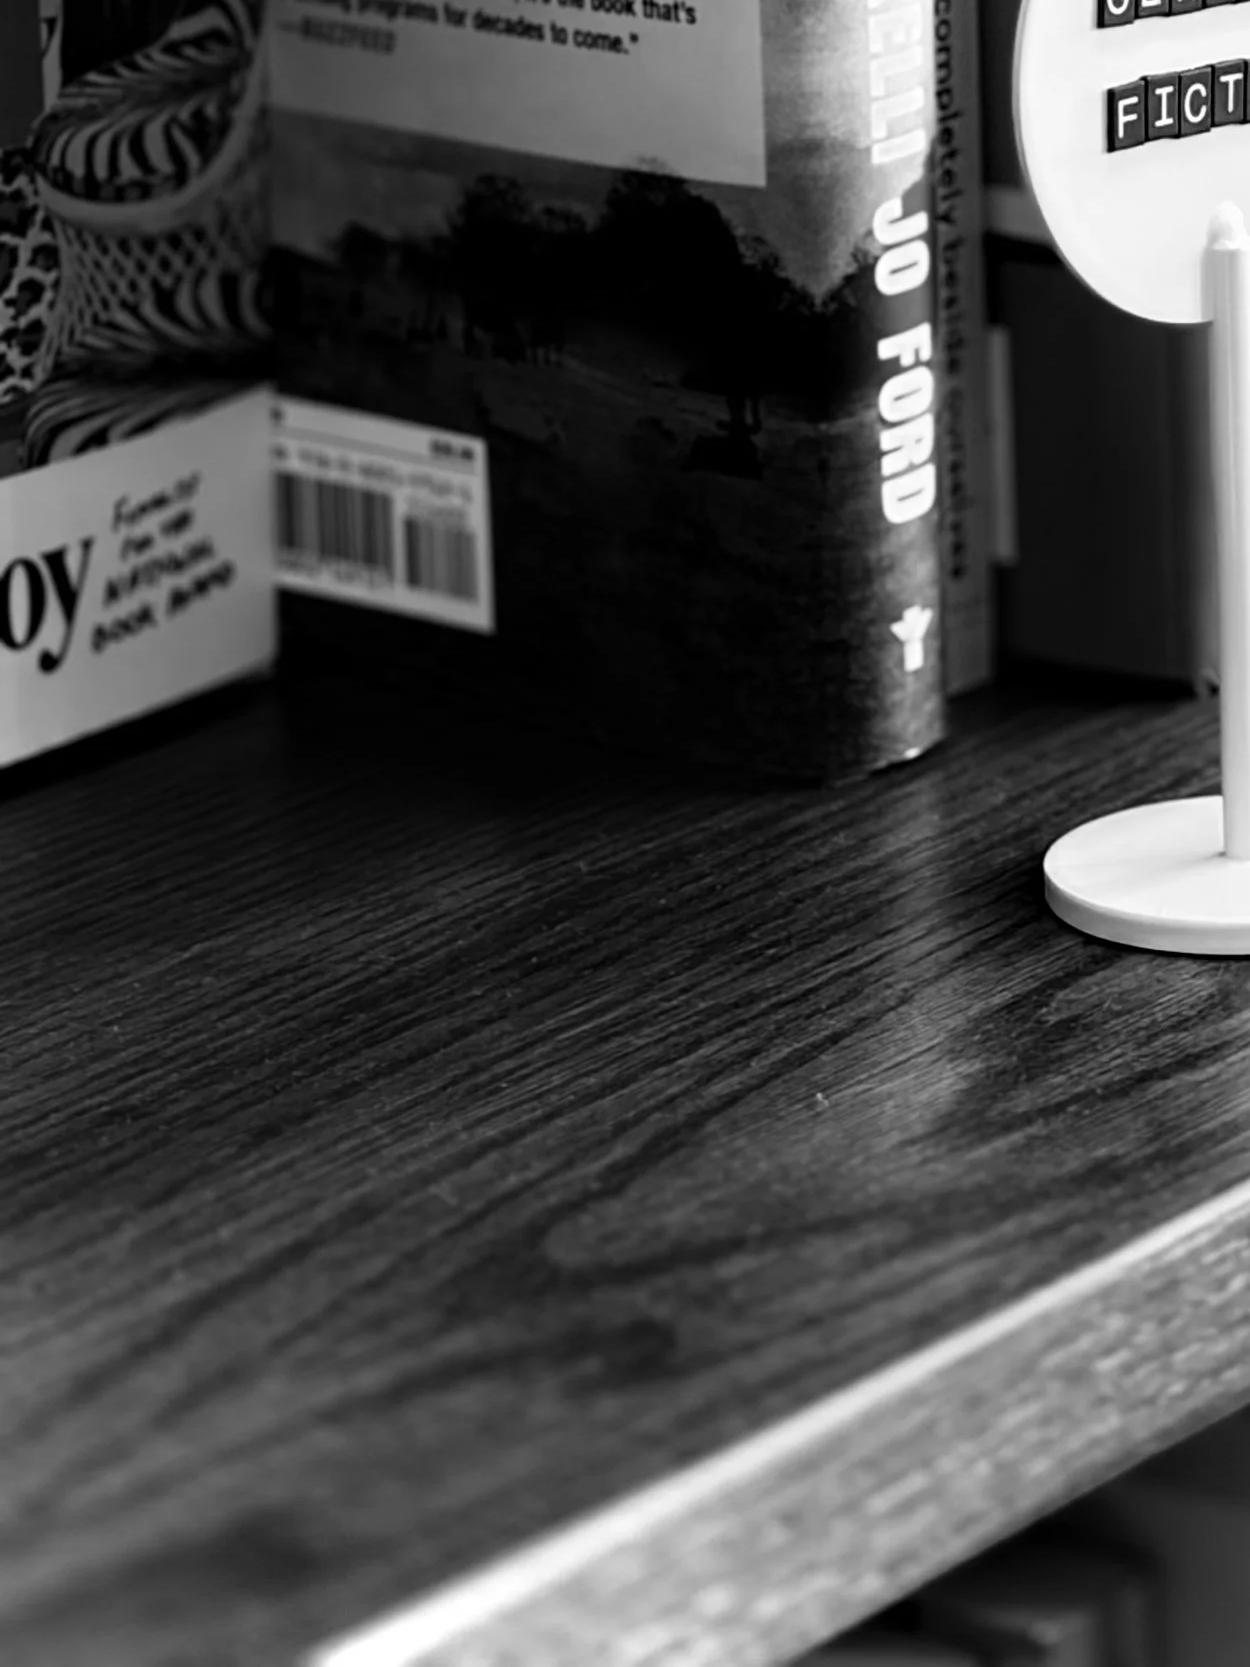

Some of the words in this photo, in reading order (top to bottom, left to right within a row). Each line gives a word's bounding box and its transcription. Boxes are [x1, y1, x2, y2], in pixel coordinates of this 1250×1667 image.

[573, 30, 638, 53] come."
[872, 198, 931, 297] JO
[877, 320, 937, 526] FORD
